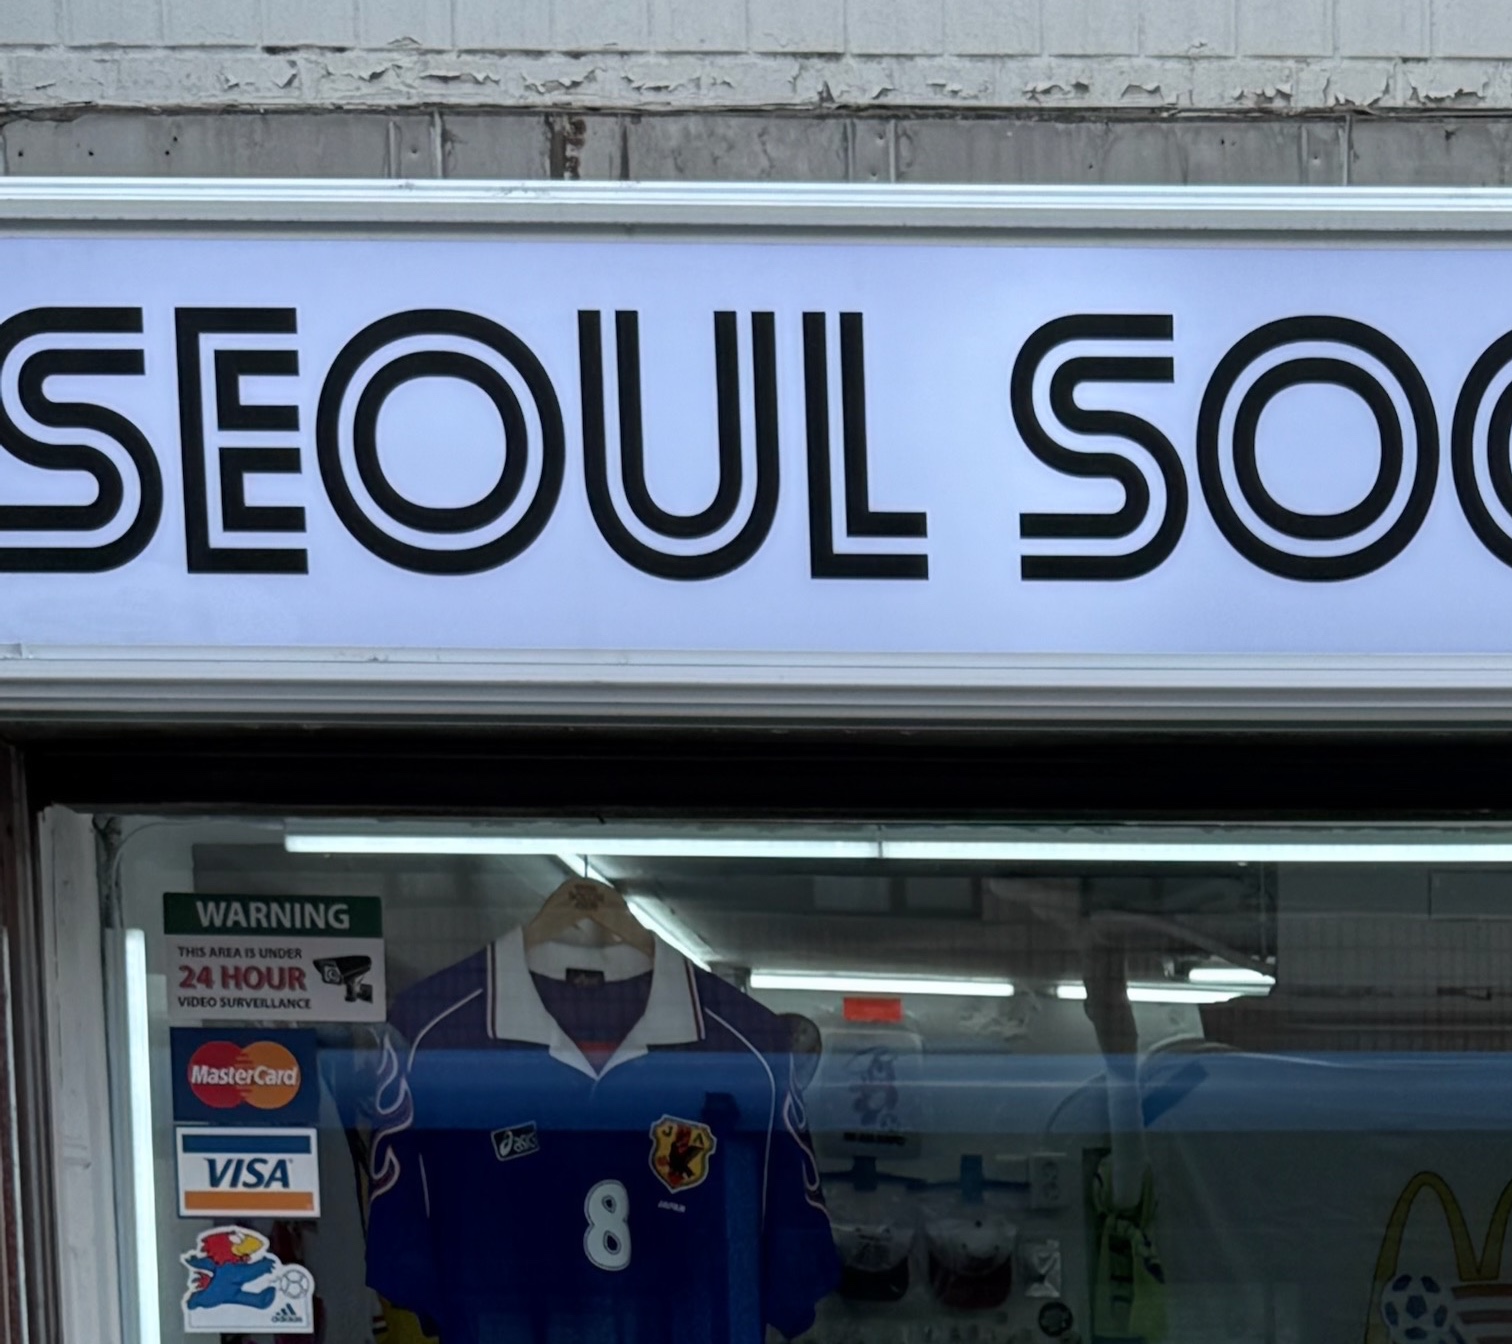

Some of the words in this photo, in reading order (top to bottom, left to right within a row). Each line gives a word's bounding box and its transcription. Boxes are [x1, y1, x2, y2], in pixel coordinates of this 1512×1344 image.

[0, 305, 929, 581] SEOUL
[195, 900, 350, 931] WARNING
[177, 946, 207, 959] THIS
[209, 947, 242, 959] AREA
[245, 948, 256, 959] IS
[259, 948, 303, 960] UNDER
[178, 965, 215, 991] 24
[219, 965, 308, 991] HOUR
[177, 996, 217, 1008] VIDEO
[219, 997, 312, 1009] SURVEILLANCE
[190, 1062, 297, 1088] MasterCard
[203, 1157, 290, 1189] VISA
[584, 1178, 632, 1271] 8
